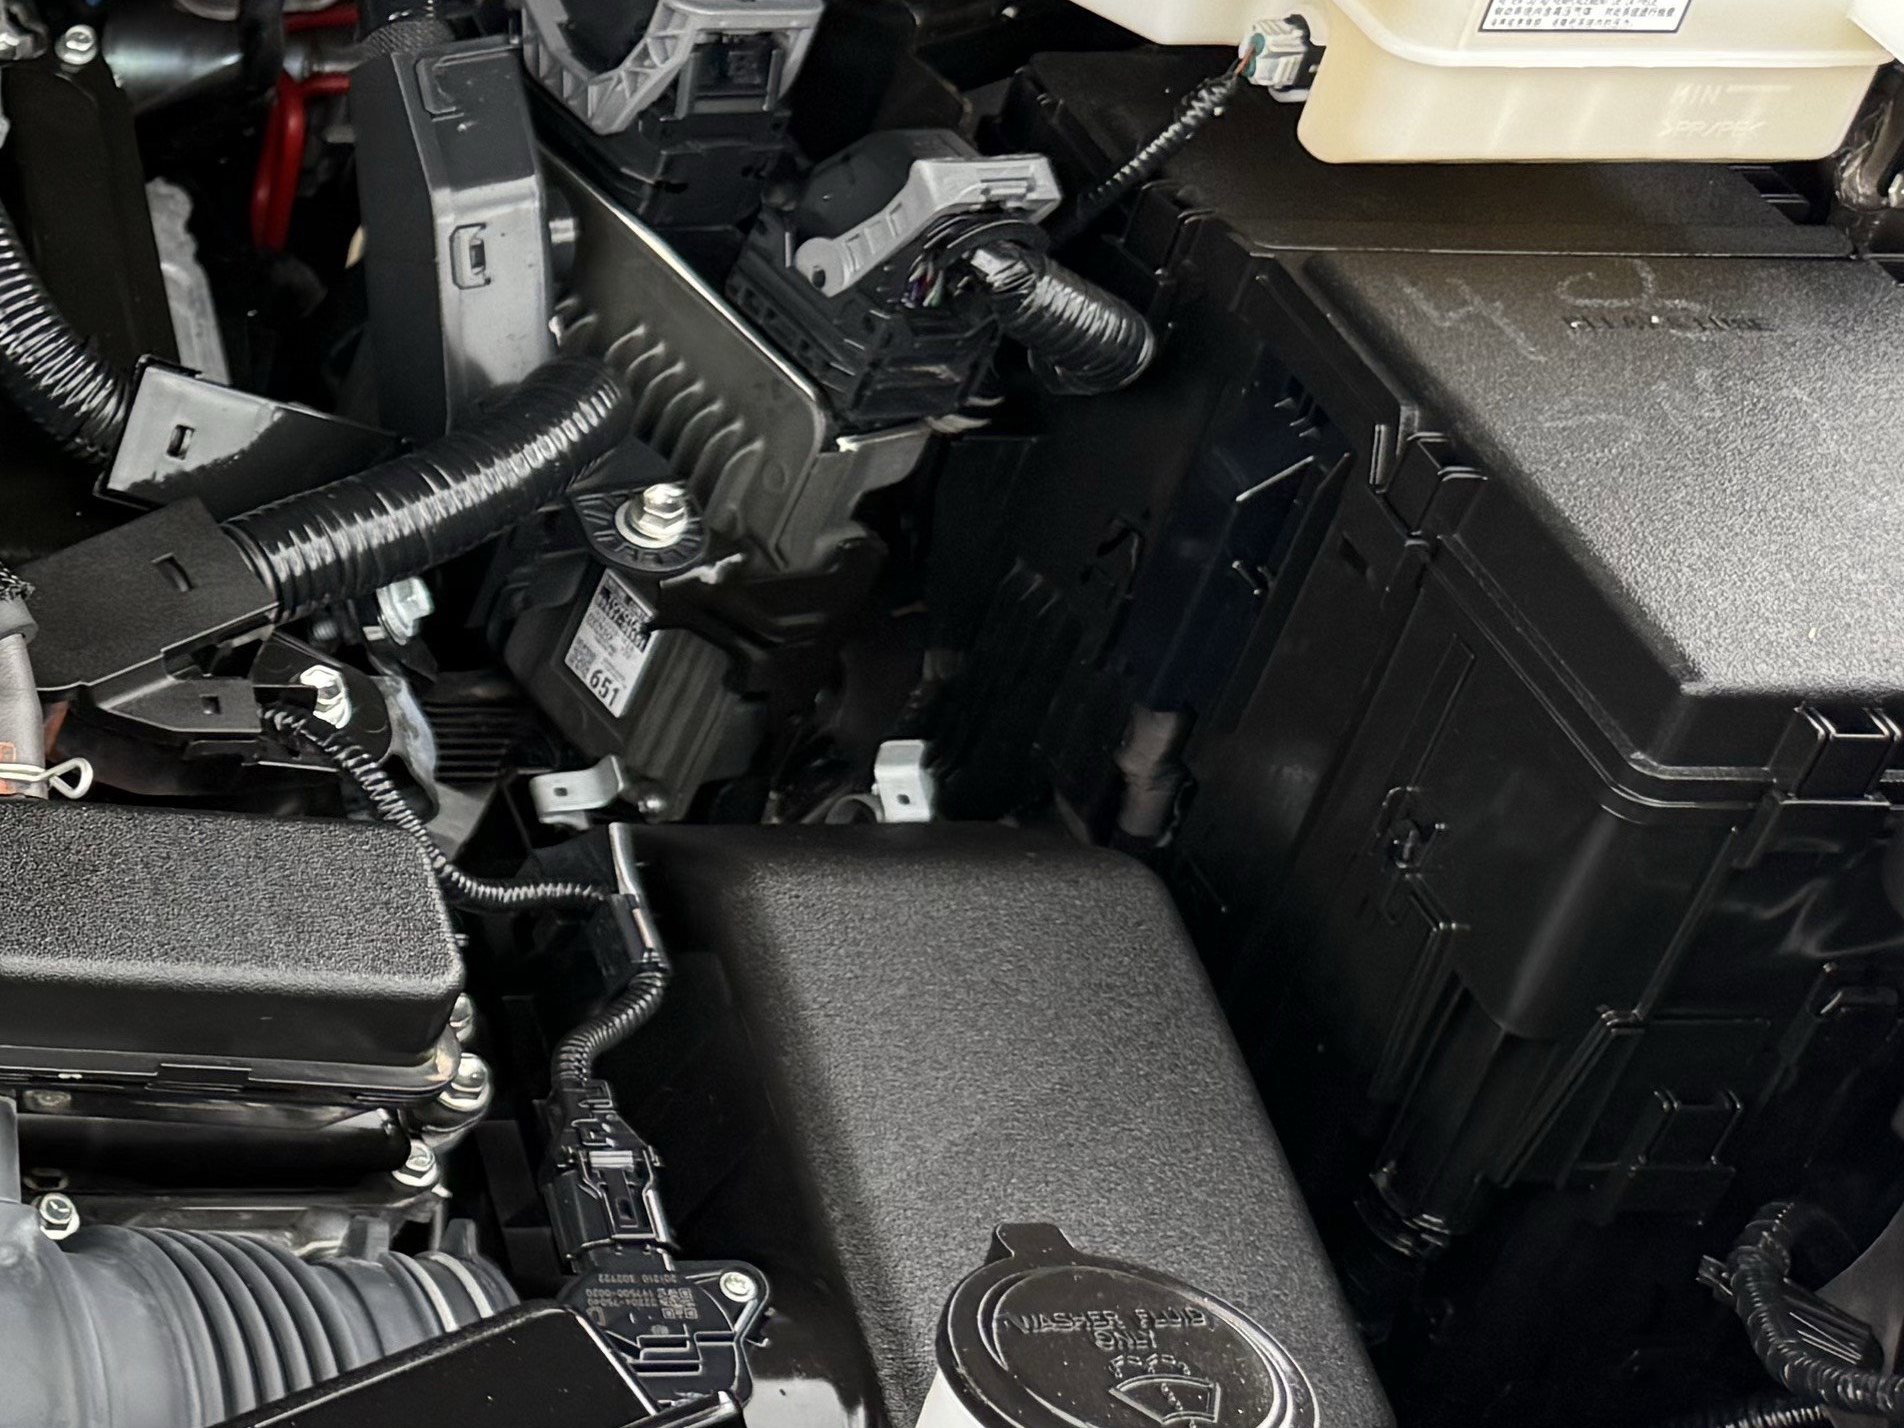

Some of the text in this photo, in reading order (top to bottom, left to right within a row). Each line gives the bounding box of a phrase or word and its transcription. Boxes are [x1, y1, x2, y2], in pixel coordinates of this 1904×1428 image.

[589, 669, 620, 707] 651
[1005, 1307, 1207, 1335] WASHER FLUID
[1094, 1329, 1158, 1351] ONLY
